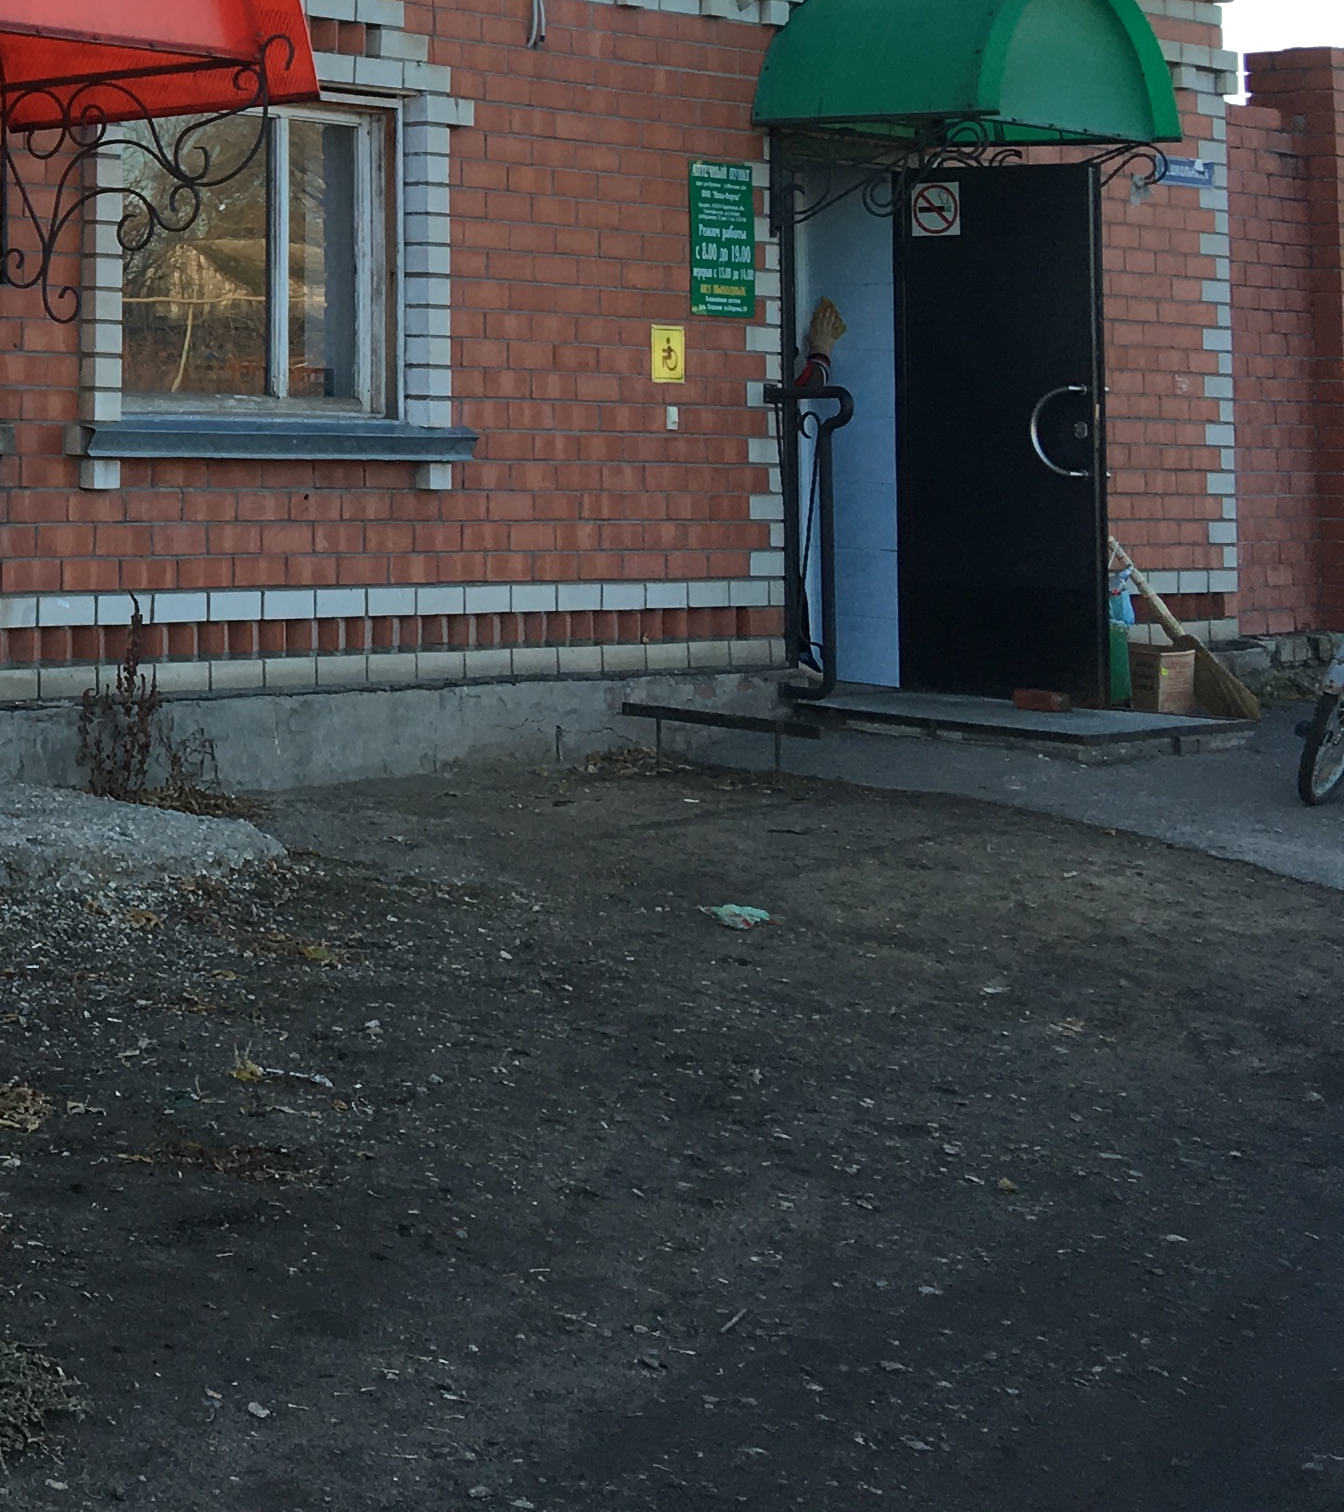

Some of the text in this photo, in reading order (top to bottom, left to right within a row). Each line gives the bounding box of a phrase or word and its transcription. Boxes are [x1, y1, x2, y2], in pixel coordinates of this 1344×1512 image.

[722, 224, 746, 241] работы
[701, 242, 717, 260] 8.00
[719, 247, 729, 264] до
[731, 245, 751, 263] 19.00
